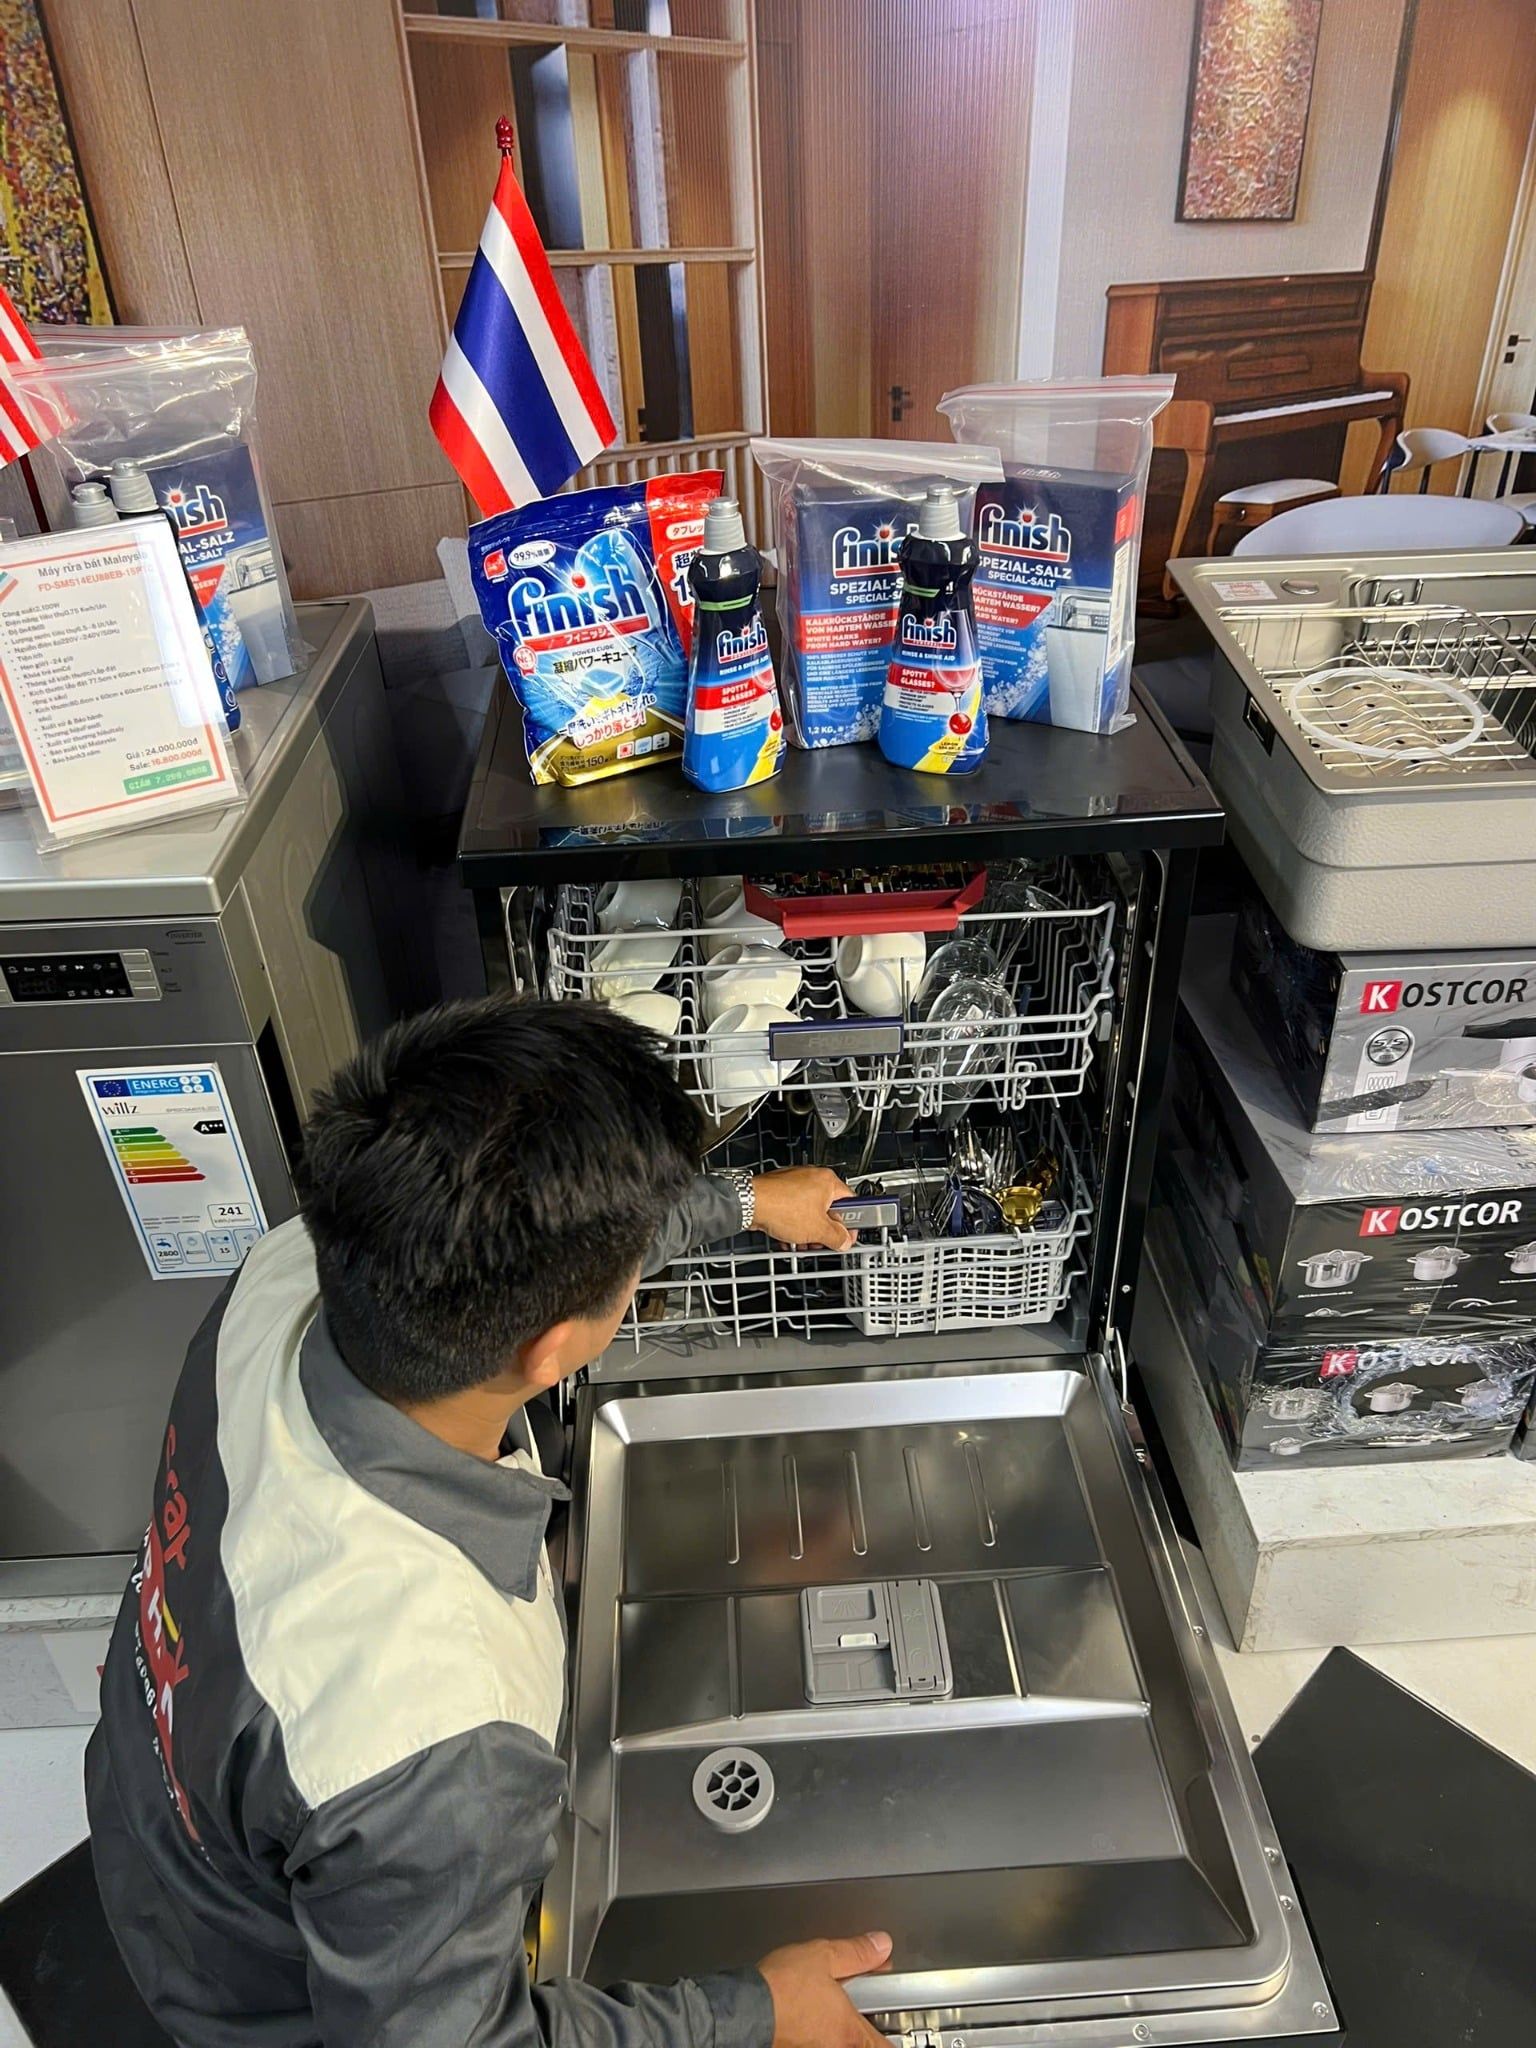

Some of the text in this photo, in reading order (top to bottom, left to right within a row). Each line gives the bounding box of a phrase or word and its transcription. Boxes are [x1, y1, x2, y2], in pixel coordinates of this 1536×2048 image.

[979, 503, 1072, 556] finish
[180, 532, 235, 554] AL-SALZ
[185, 548, 223, 565] AL-SALT
[38, 565, 63, 577] Máy
[979, 556, 1072, 580] SPEZIAL-SALZ
[830, 577, 904, 595] SPEZIAL-S
[988, 570, 1056, 588] SPECIAL-SALT
[846, 591, 902, 604] SPECIAL-S
[972, 587, 1024, 602] RÜCKSTÄNDE
[508, 565, 648, 640] finish
[974, 596, 1041, 613] ARTEM WASSER?
[806, 626, 826, 635] VON
[826, 624, 862, 633] HARTEM
[902, 614, 956, 644] finish
[716, 622, 768, 659] finish
[902, 668, 928, 680] SPOTTY
[722, 682, 750, 695] SPOTTY
[900, 677, 936, 688] GLASSES?
[721, 689, 757, 704] GLASSES?
[808, 726, 820, 735] 1,2
[130, 761, 150, 772] Sale:
[1367, 978, 1528, 1010] KOSTCOR
[132, 1078, 180, 1091] ENERG
[102, 1102, 140, 1115] willz
[218, 1206, 244, 1216] 241
[1367, 1200, 1522, 1233] KOSTCOR
[158, 1250, 180, 1258] 2800
